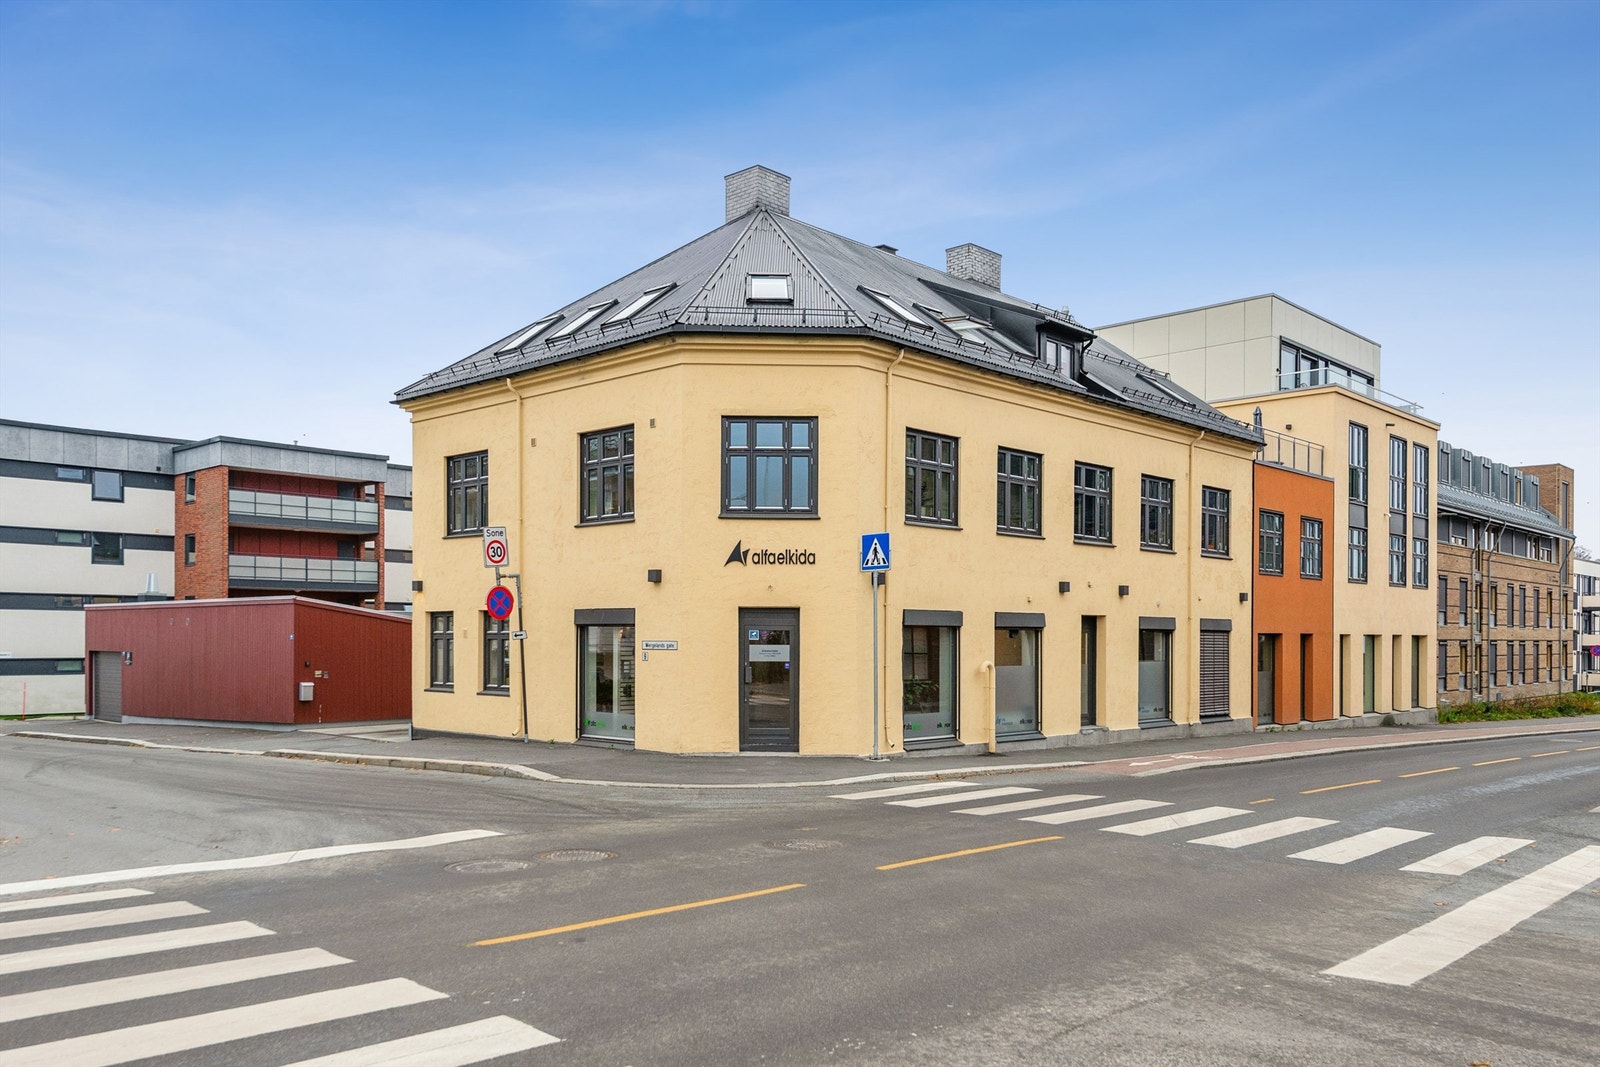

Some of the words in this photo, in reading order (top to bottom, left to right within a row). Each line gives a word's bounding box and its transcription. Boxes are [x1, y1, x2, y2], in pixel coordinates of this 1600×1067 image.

[486, 529, 504, 537] Sone
[490, 546, 503, 558] 30
[751, 549, 816, 565] alfaelkida
